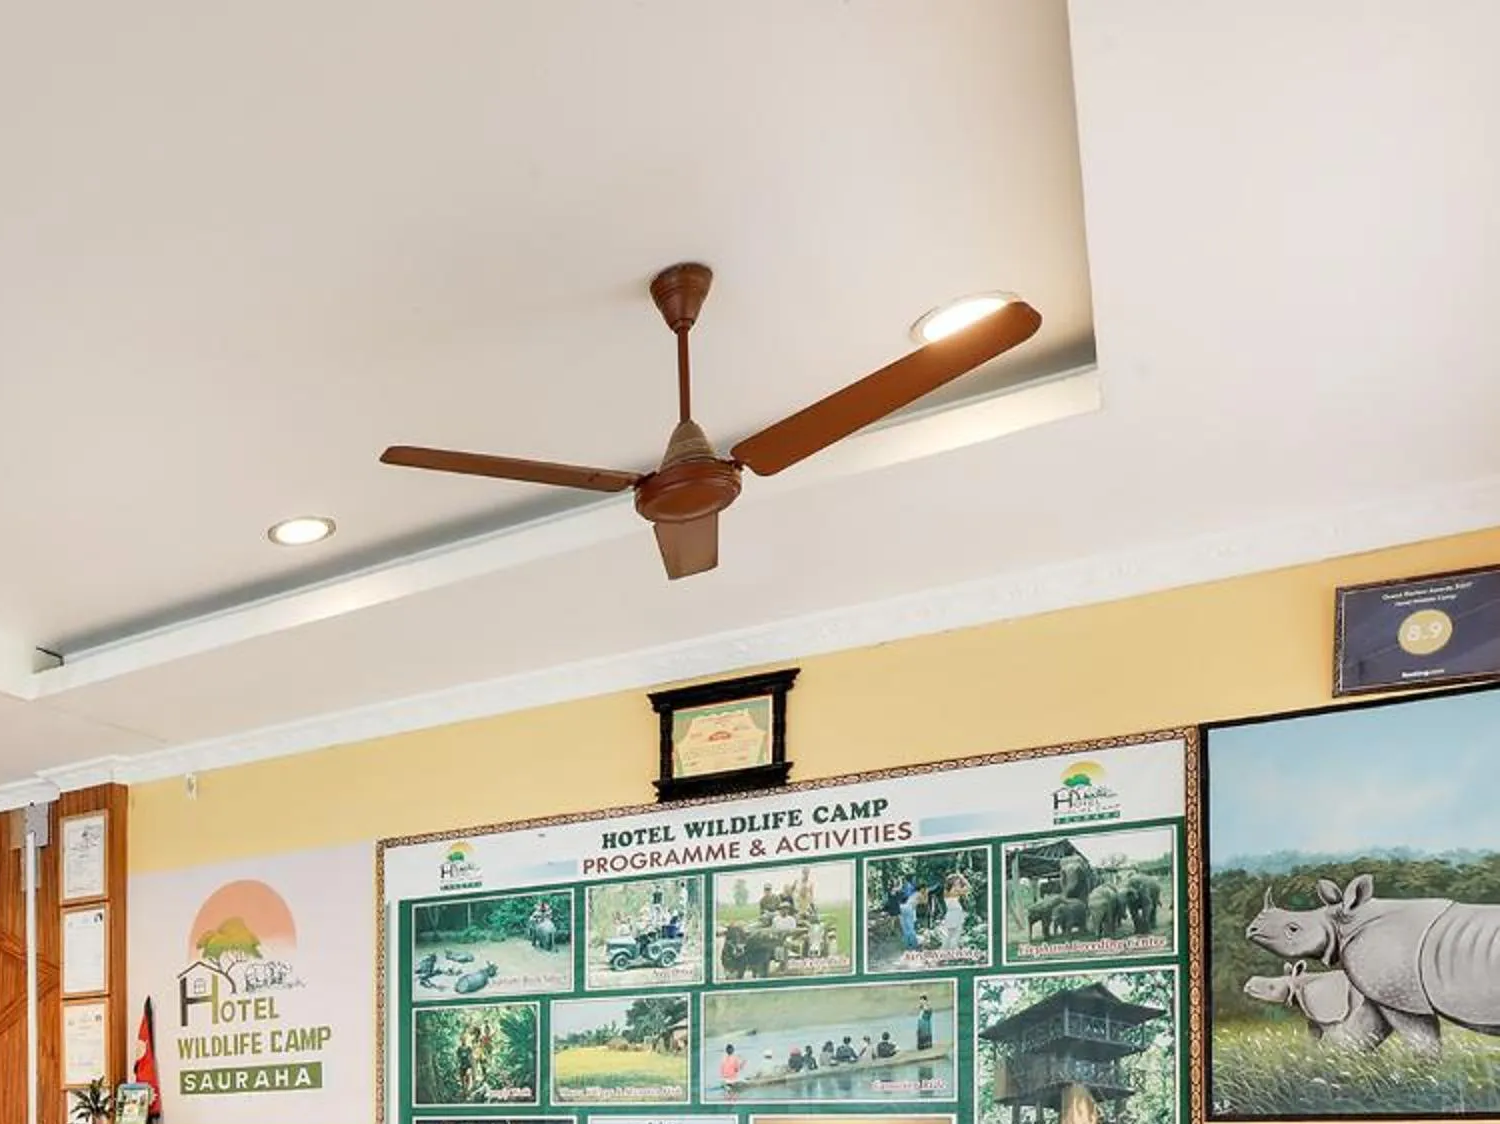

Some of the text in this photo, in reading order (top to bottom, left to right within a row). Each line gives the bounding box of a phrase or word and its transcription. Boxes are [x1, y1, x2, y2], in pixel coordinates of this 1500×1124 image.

[582, 821, 913, 876] PROGRAMME & ACTIVITIES
[601, 798, 889, 849] HOTEL WILDLIFE CAMP
[180, 973, 280, 1027] HOTEL
[177, 1026, 332, 1060] WILDLIFE CAMP
[184, 1067, 312, 1092] SAURAHA
